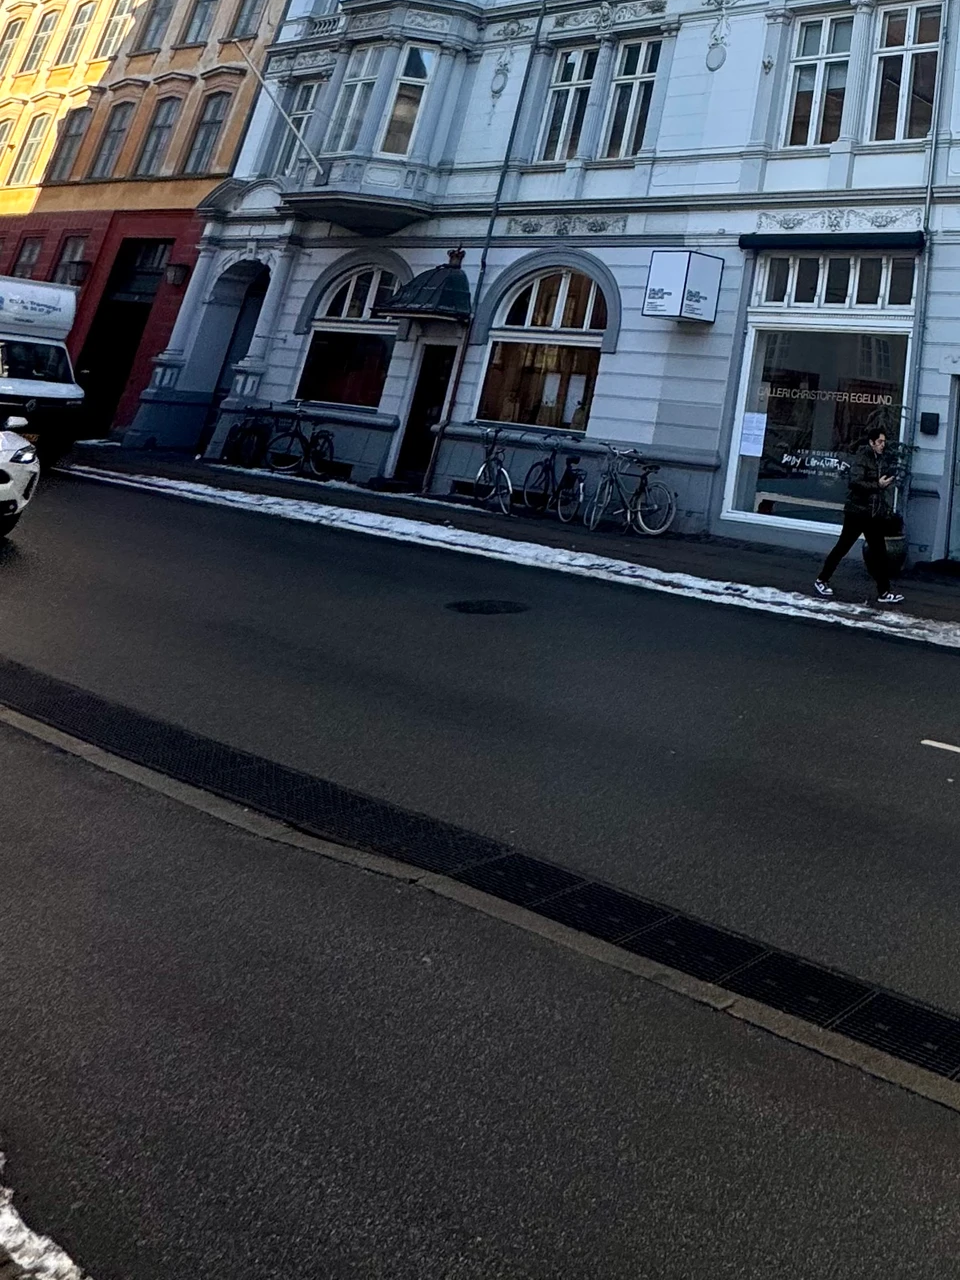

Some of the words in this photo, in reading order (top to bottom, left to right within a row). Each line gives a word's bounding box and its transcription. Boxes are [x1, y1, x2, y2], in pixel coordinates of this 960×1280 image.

[757, 387, 790, 398] GALLERI
[791, 389, 848, 402] CHRISTOFFER
[850, 393, 892, 405] EGELUND
